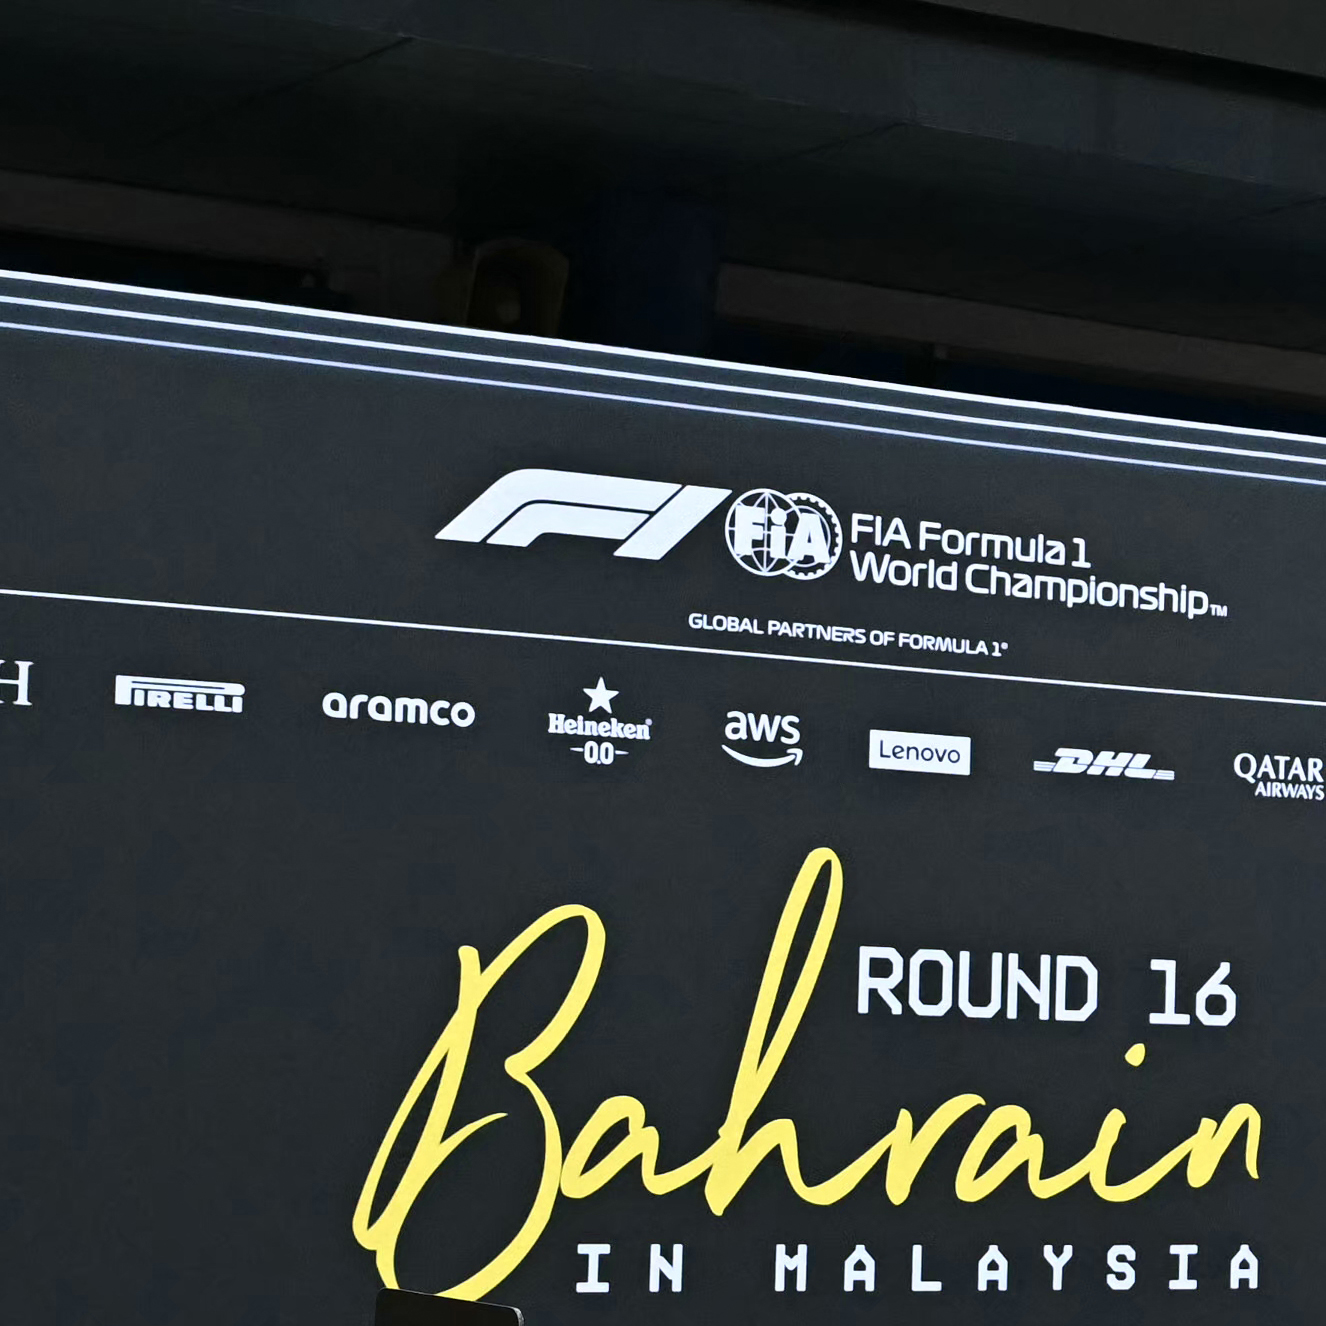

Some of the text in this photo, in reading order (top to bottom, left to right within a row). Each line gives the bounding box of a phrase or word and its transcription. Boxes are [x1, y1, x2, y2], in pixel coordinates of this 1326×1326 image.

[851, 512, 1091, 568] FIA Formula 1
[849, 550, 957, 592] World
[688, 612, 988, 656] GLOBAL PARTNERS OF FORMULA
[115, 675, 245, 713] PIRELLI
[322, 692, 475, 728] aramco
[724, 710, 801, 745] aws
[879, 739, 961, 766] Lenovo
[1048, 746, 1158, 780] DHL
[1233, 752, 1324, 783] QATAR
[1255, 781, 1325, 802] AIRWAYS
[857, 946, 1236, 1027] ROUND 16
[352, 847, 1261, 1301] Bahrain
[575, 1242, 1260, 1293] IN MALAYSIA
